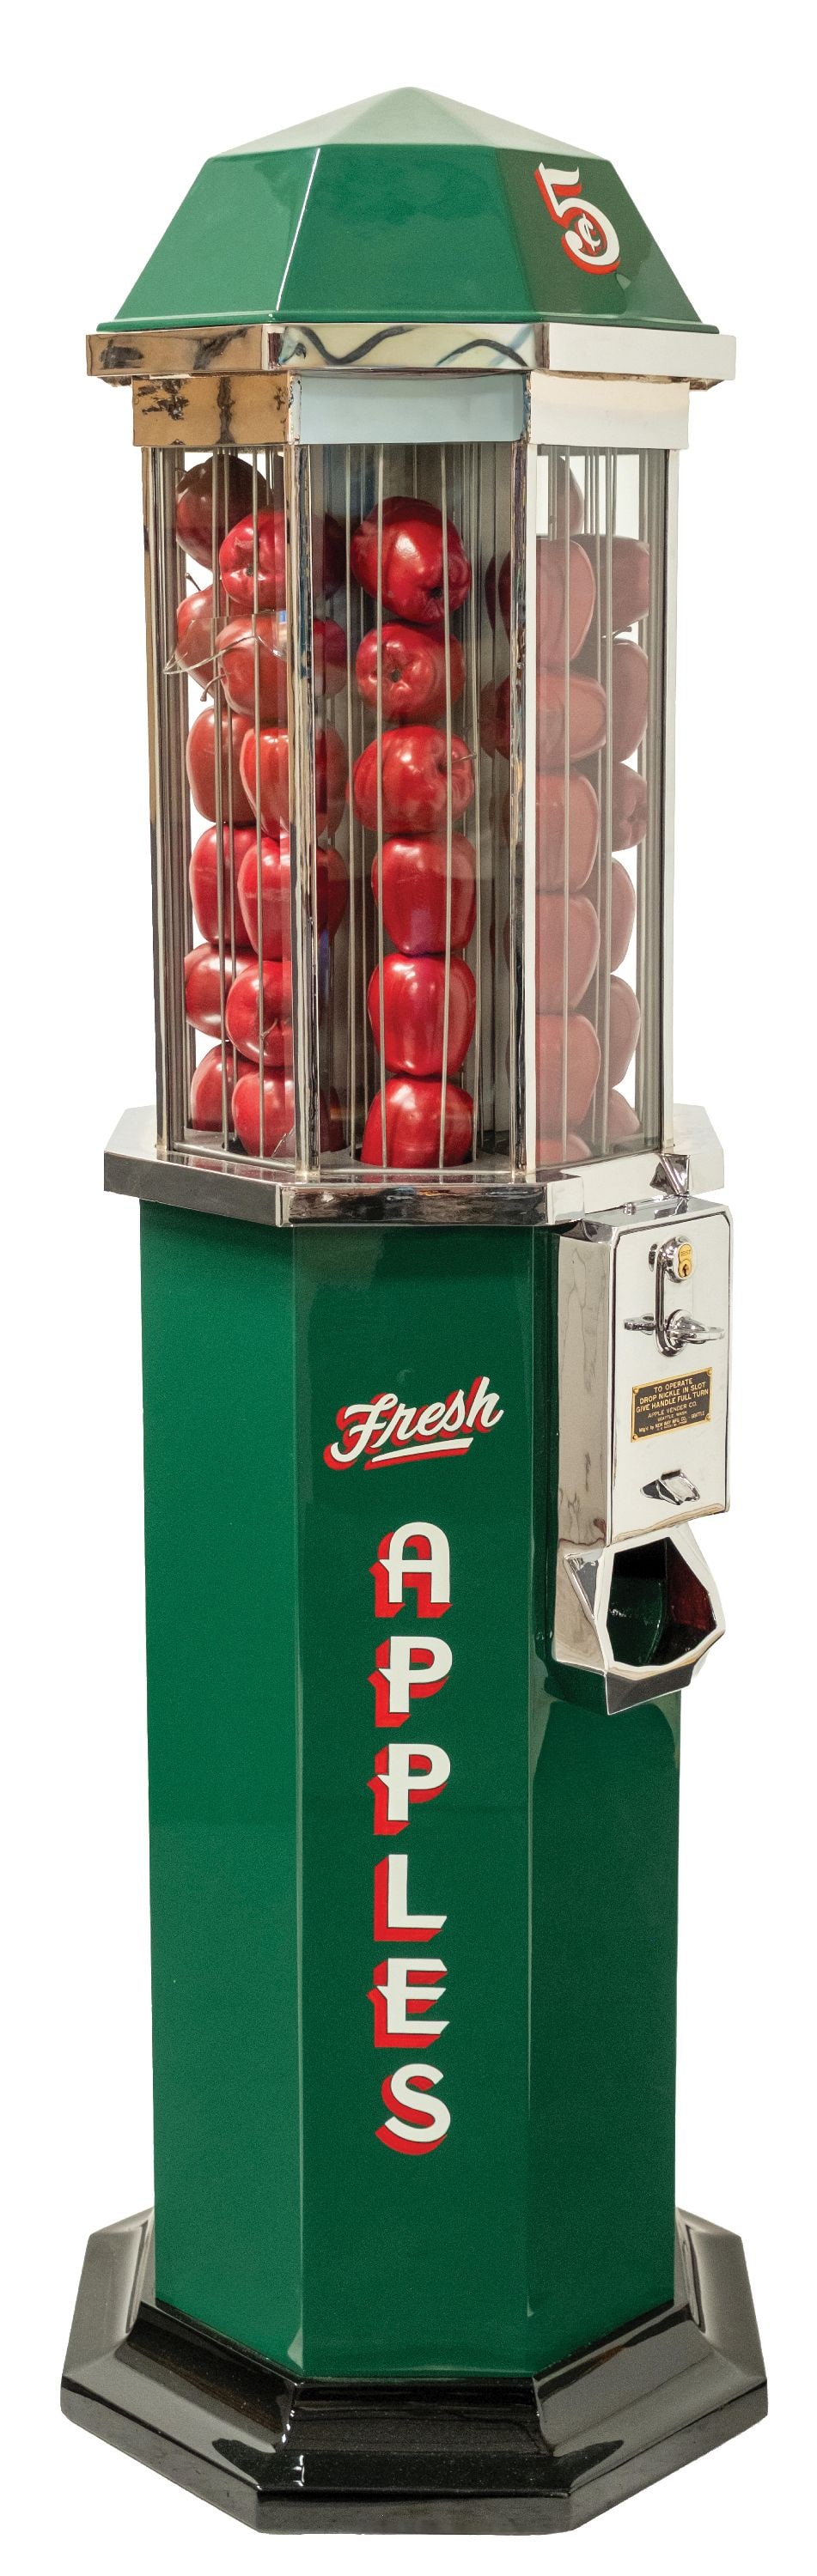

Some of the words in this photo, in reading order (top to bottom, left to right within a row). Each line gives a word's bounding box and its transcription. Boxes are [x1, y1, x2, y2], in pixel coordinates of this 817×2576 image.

[640, 1394, 657, 1404] DROP
[658, 1389, 680, 1400] NICKLE
[690, 1382, 706, 1391] SLOT
[665, 1378, 693, 1391] OPERATE
[636, 1404, 650, 1413] GIVE
[652, 1397, 676, 1409] HANDLE
[677, 1394, 692, 1402] FULL
[693, 1389, 708, 1398] TURN
[648, 1409, 664, 1419] APPLE
[666, 1403, 687, 1414] VENDER
[322, 1376, 504, 1471] Fresh
[365, 1521, 454, 2157] APPLES
